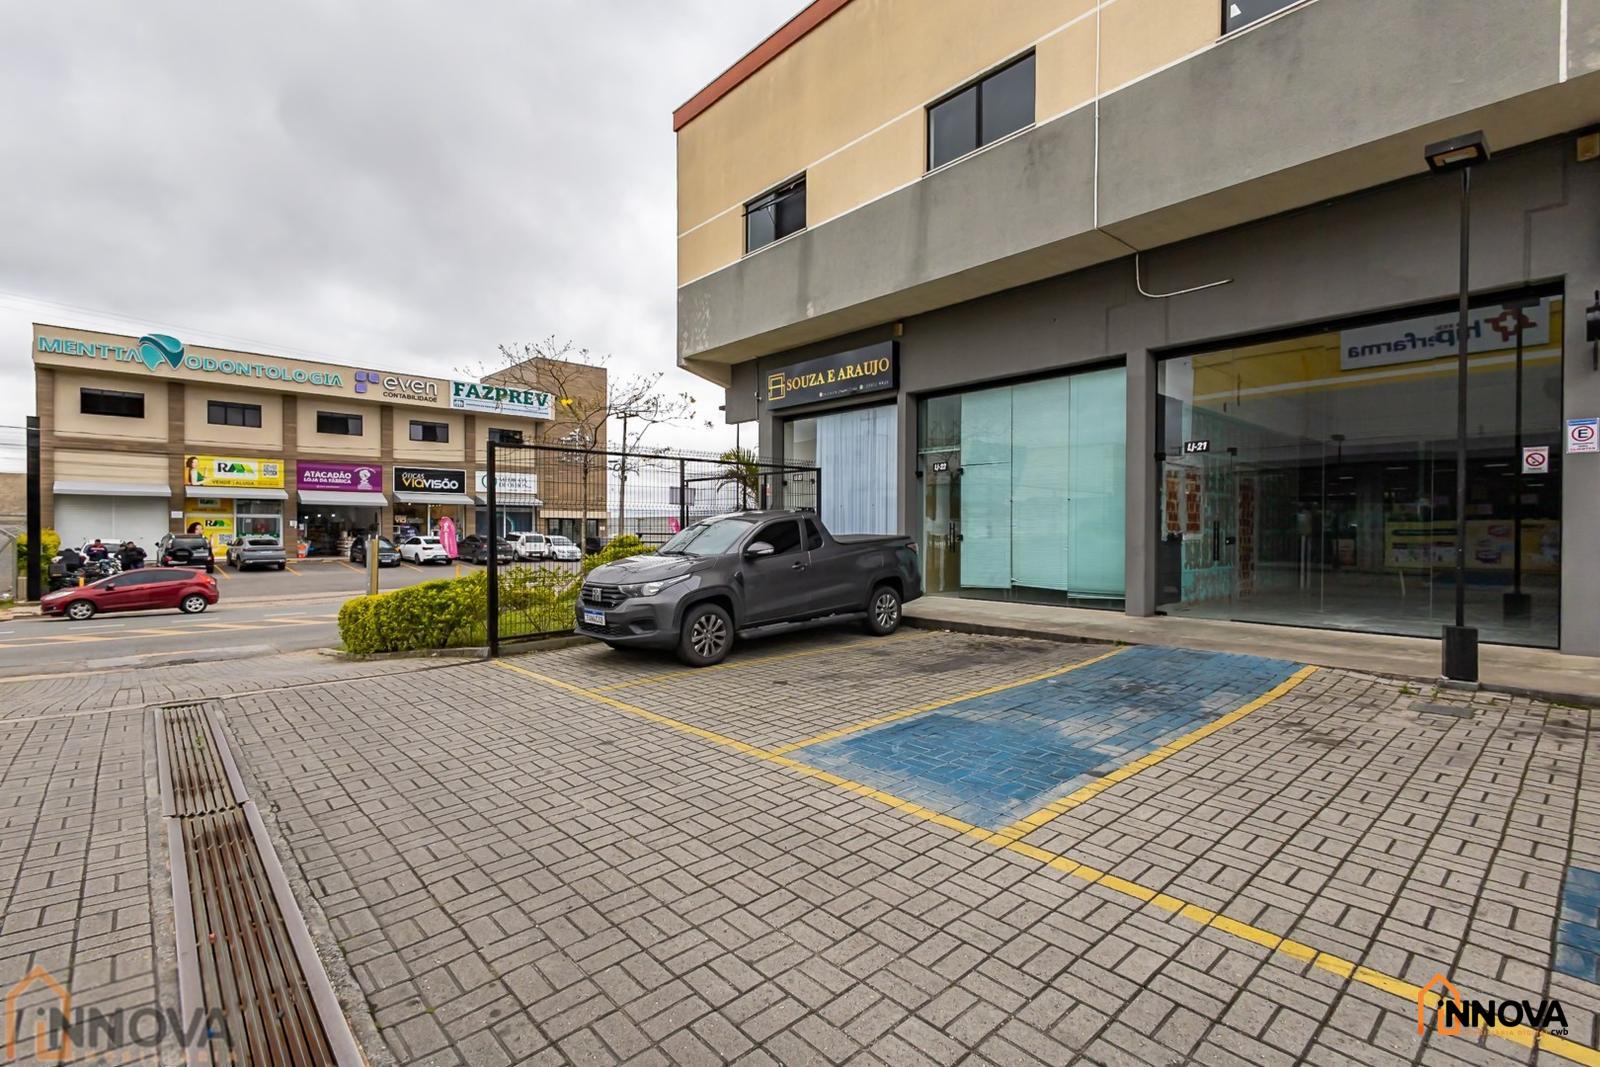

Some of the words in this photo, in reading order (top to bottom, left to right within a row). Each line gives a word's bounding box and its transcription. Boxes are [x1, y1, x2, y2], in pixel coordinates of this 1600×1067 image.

[38, 336, 142, 363] MENTTA
[184, 355, 343, 387] ODONTOLOGIA
[786, 372, 824, 391] SOUZA
[827, 368, 835, 383] E
[838, 357, 889, 380] ARAUJO
[383, 376, 437, 396] even
[453, 382, 548, 406] FAZPREV
[382, 391, 437, 403] CONTABILIDADE
[1578, 429, 1588, 438] E
[304, 470, 352, 479] ATACADÃO
